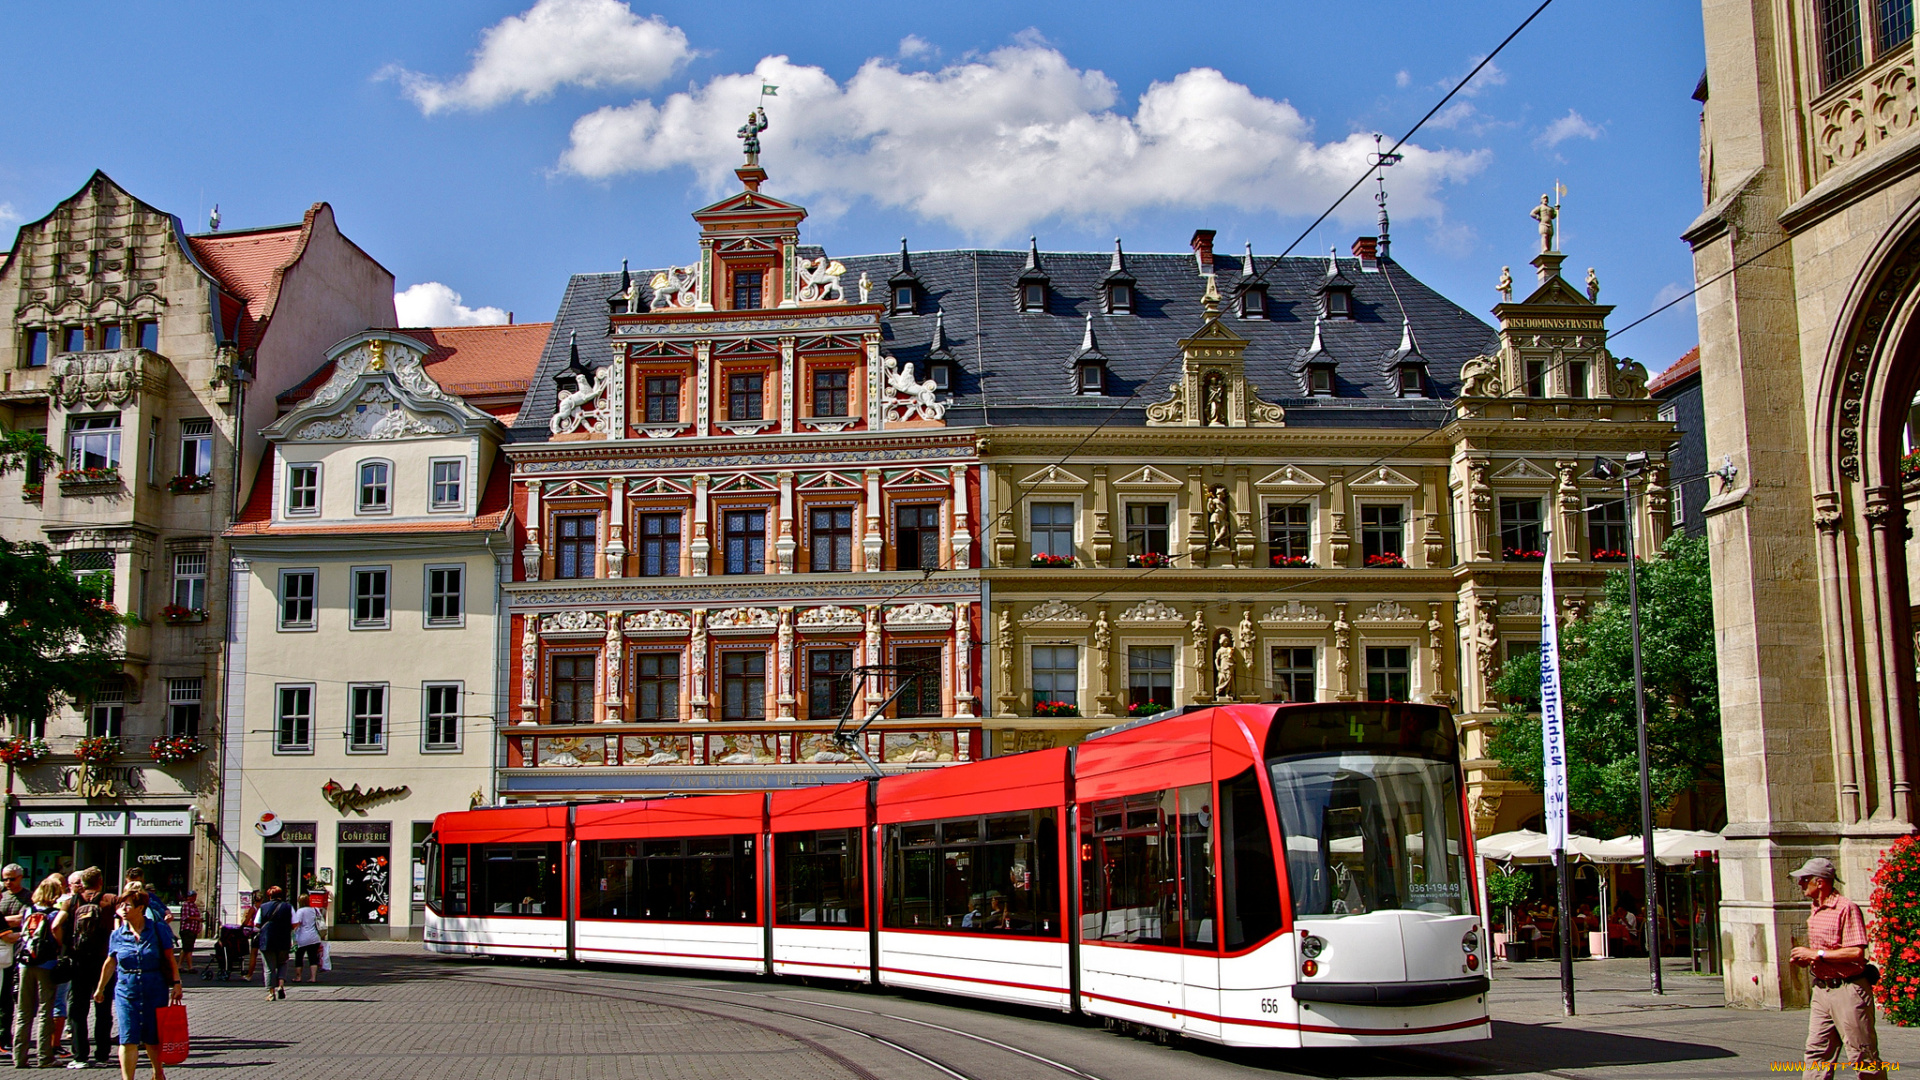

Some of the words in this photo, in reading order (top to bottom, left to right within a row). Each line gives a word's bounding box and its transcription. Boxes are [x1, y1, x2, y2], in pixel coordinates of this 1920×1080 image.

[1194, 349, 1235, 357] 1892
[1350, 715, 1364, 743] 4
[669, 776, 700, 788] ZVM
[708, 775, 769, 787] BREITEN
[26, 818, 65, 828] Kosmetik
[87, 818, 118, 828] Friseur
[136, 817, 184, 828] Parfümerie
[1409, 883, 1447, 893] 0361-194
[1449, 883, 1460, 892] 49
[1261, 998, 1278, 1013] 656
